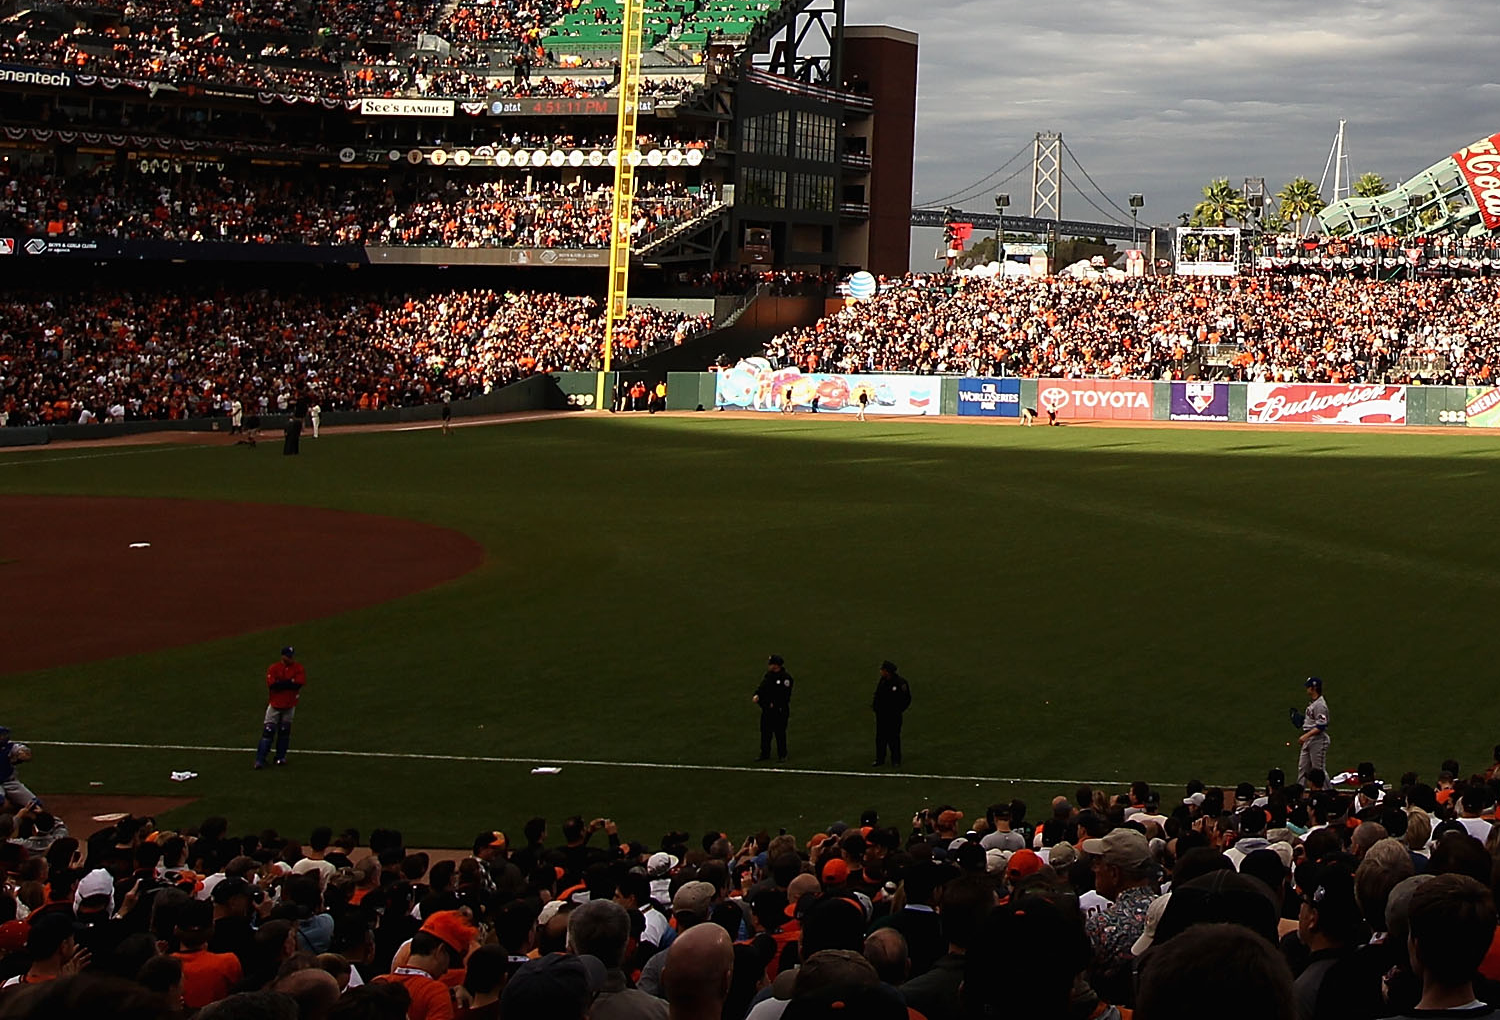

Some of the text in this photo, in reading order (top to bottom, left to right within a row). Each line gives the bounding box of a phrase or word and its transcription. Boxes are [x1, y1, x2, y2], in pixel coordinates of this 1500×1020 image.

[365, 101, 449, 114] See's CANDIES
[585, 100, 608, 113] PM
[567, 393, 594, 406] 339
[959, 391, 1019, 403] WORLD SERIES
[1071, 390, 1150, 408] TOYOTA
[1249, 384, 1388, 422] Budweiser
[1438, 410, 1466, 423] 382
